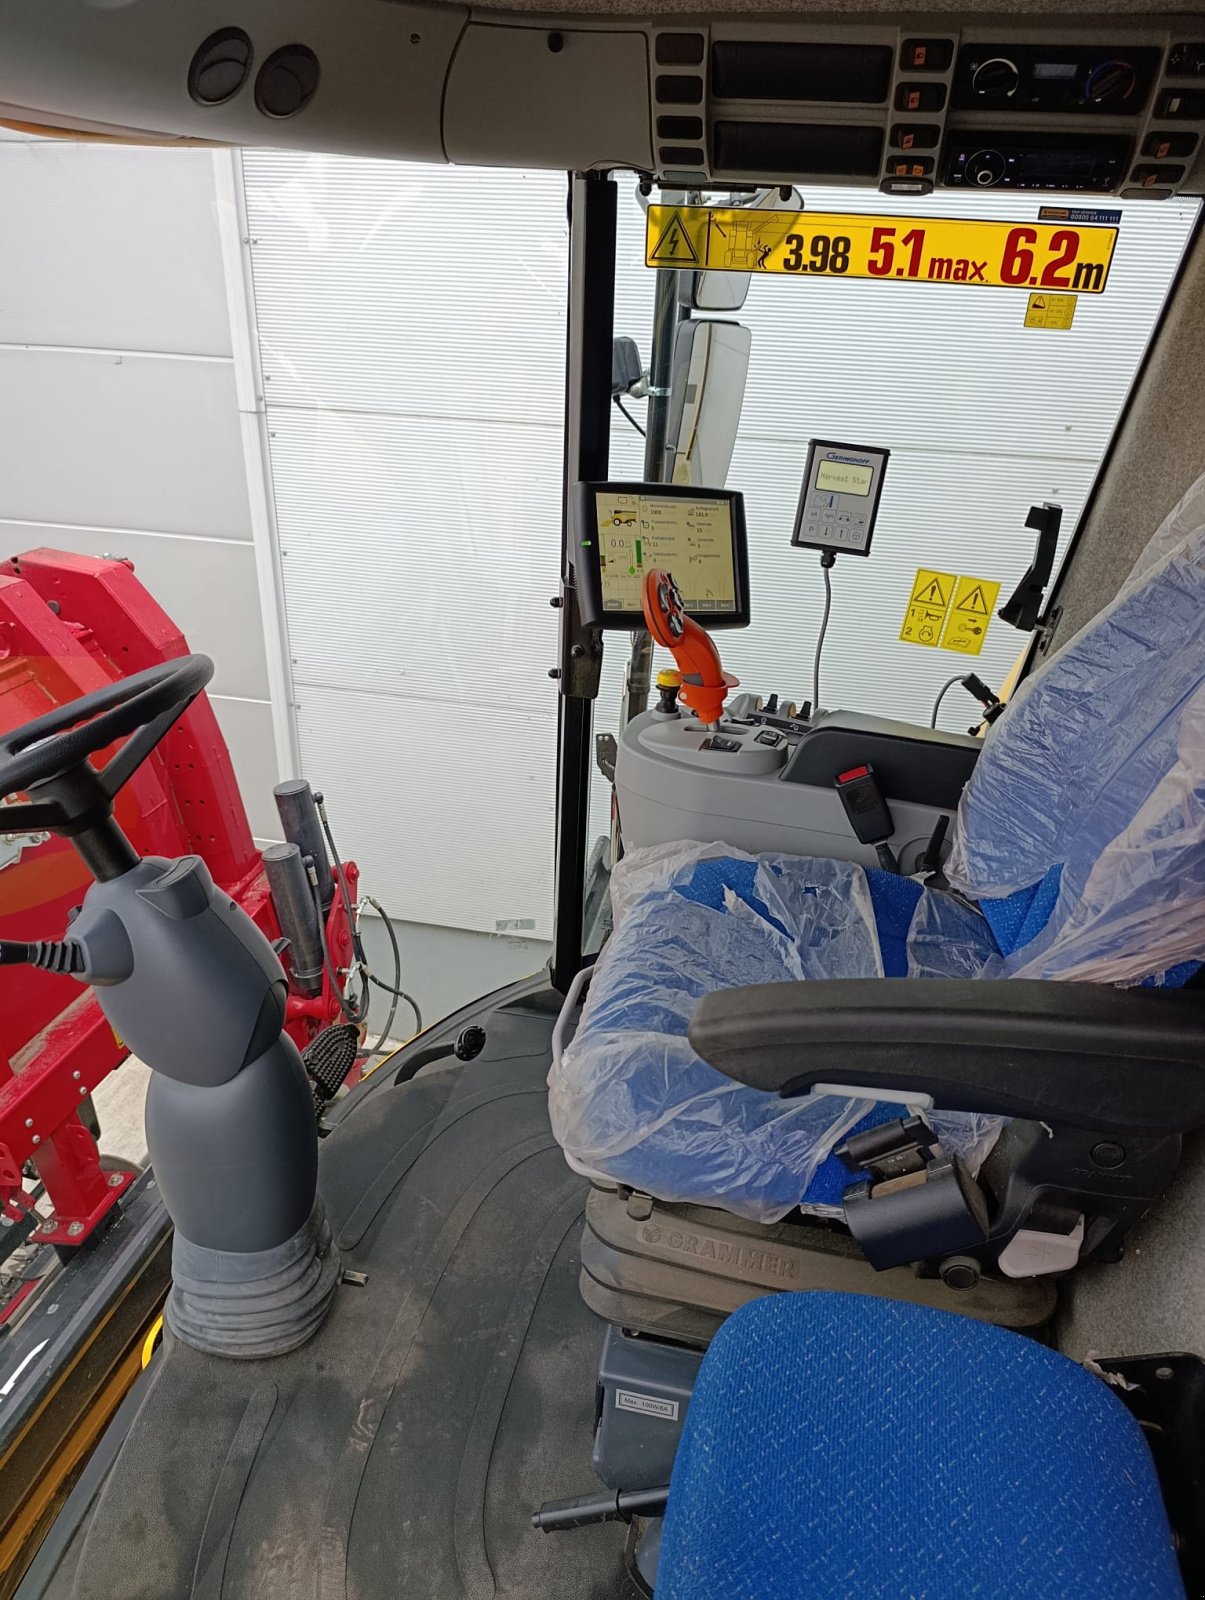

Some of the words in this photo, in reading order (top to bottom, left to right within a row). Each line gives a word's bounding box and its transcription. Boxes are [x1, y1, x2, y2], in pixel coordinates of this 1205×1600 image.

[783, 234, 851, 273] 3.98
[868, 227, 926, 277] 5.1
[820, 472, 848, 484] Harvest
[910, 609, 916, 617] 1
[905, 626, 913, 636] 2
[667, 1231, 796, 1279] GRAMMER
